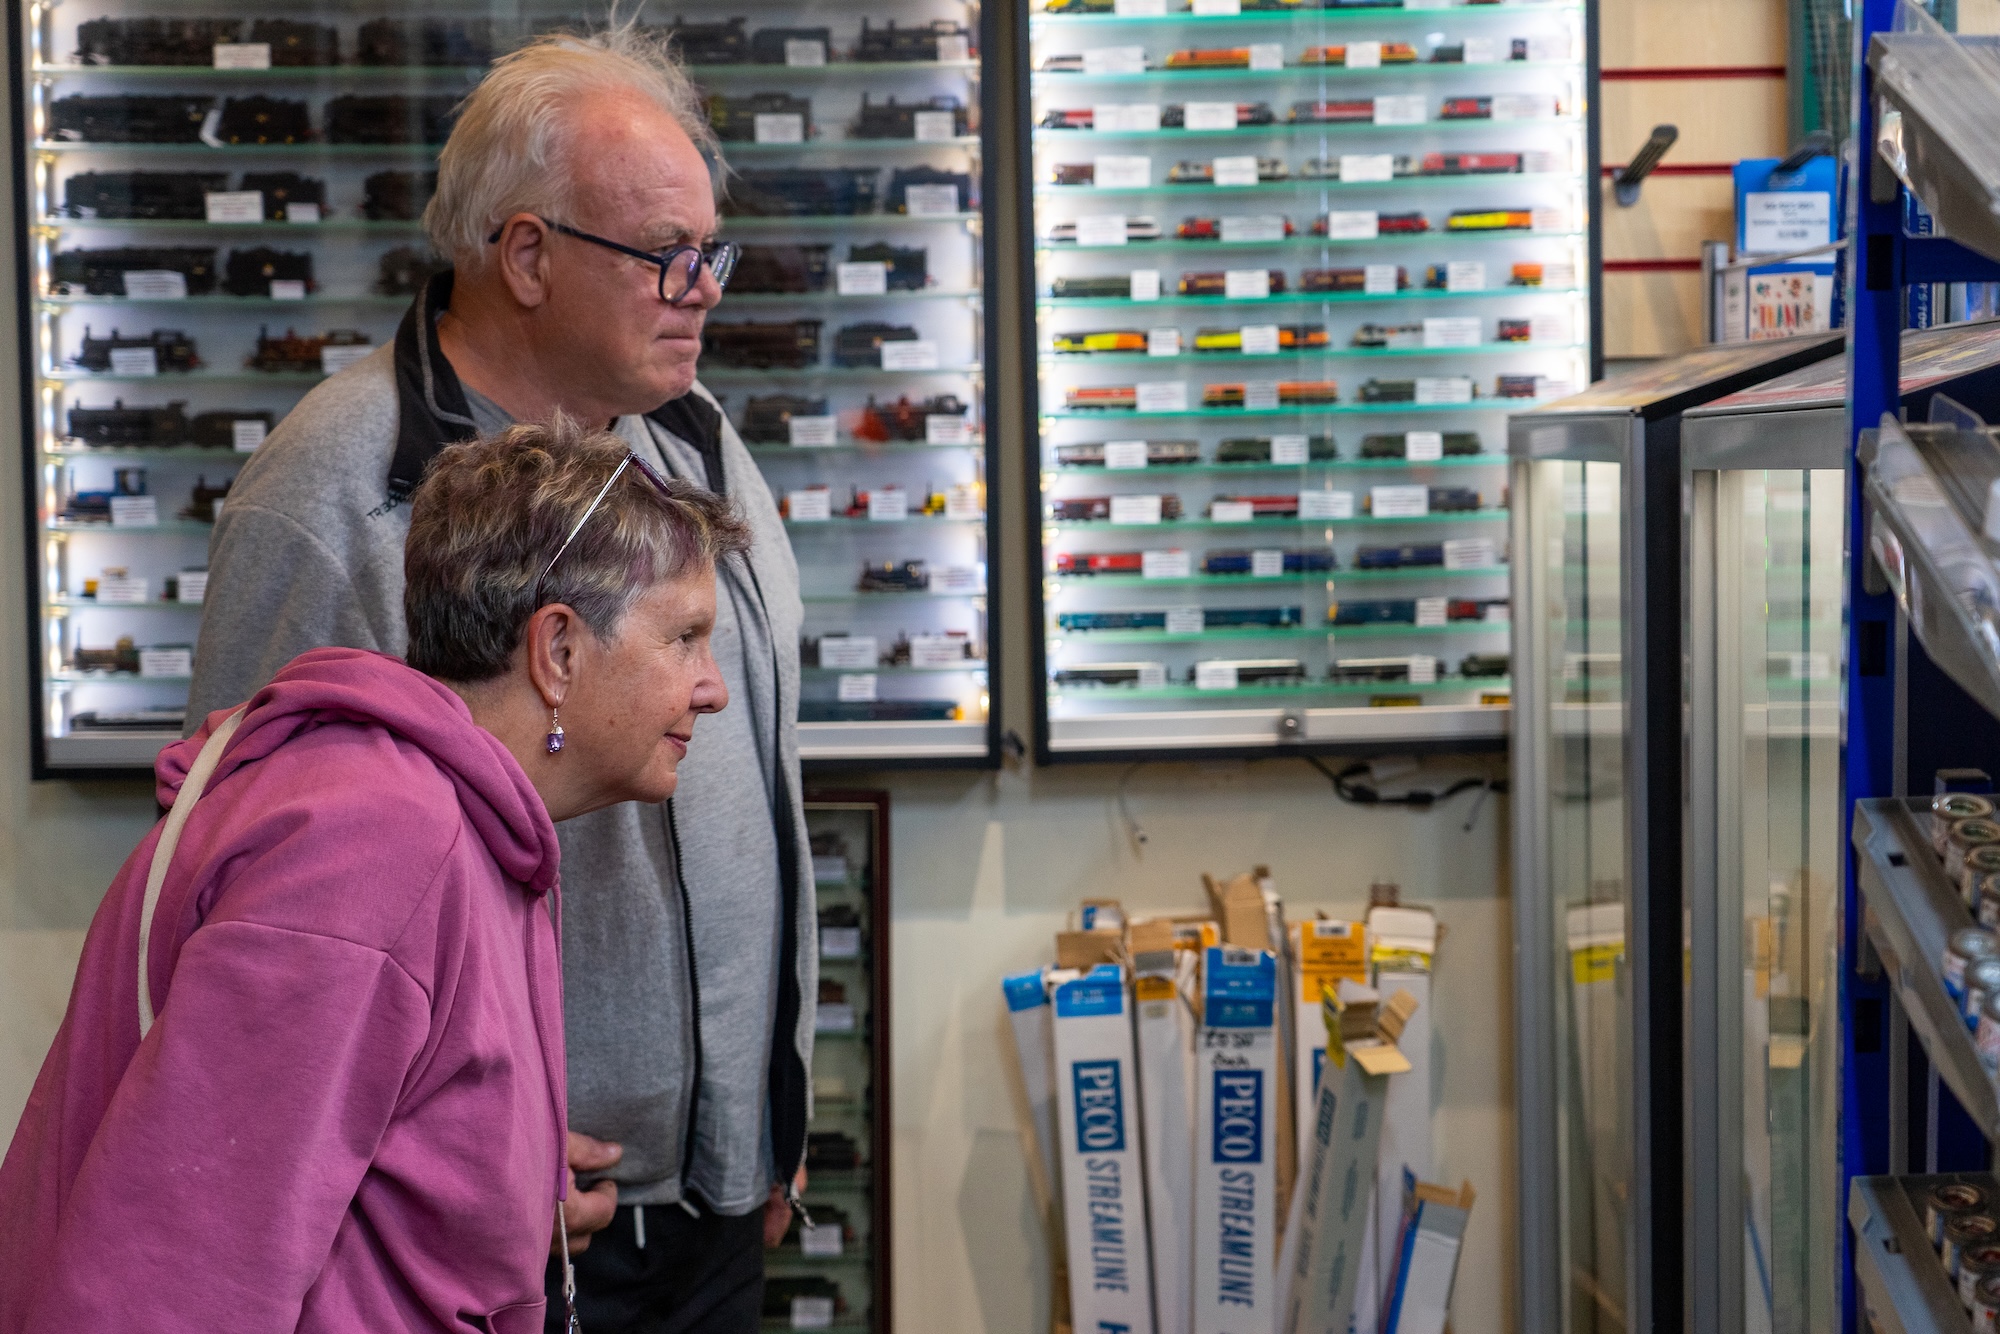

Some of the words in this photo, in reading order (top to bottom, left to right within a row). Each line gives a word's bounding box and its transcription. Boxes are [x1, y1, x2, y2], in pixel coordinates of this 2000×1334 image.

[1077, 1066, 1119, 1148] PECO
[1219, 1076, 1256, 1158] PECO
[1085, 1157, 1129, 1294] STREAMLINE
[1218, 1167, 1255, 1308] STREAMLINE
